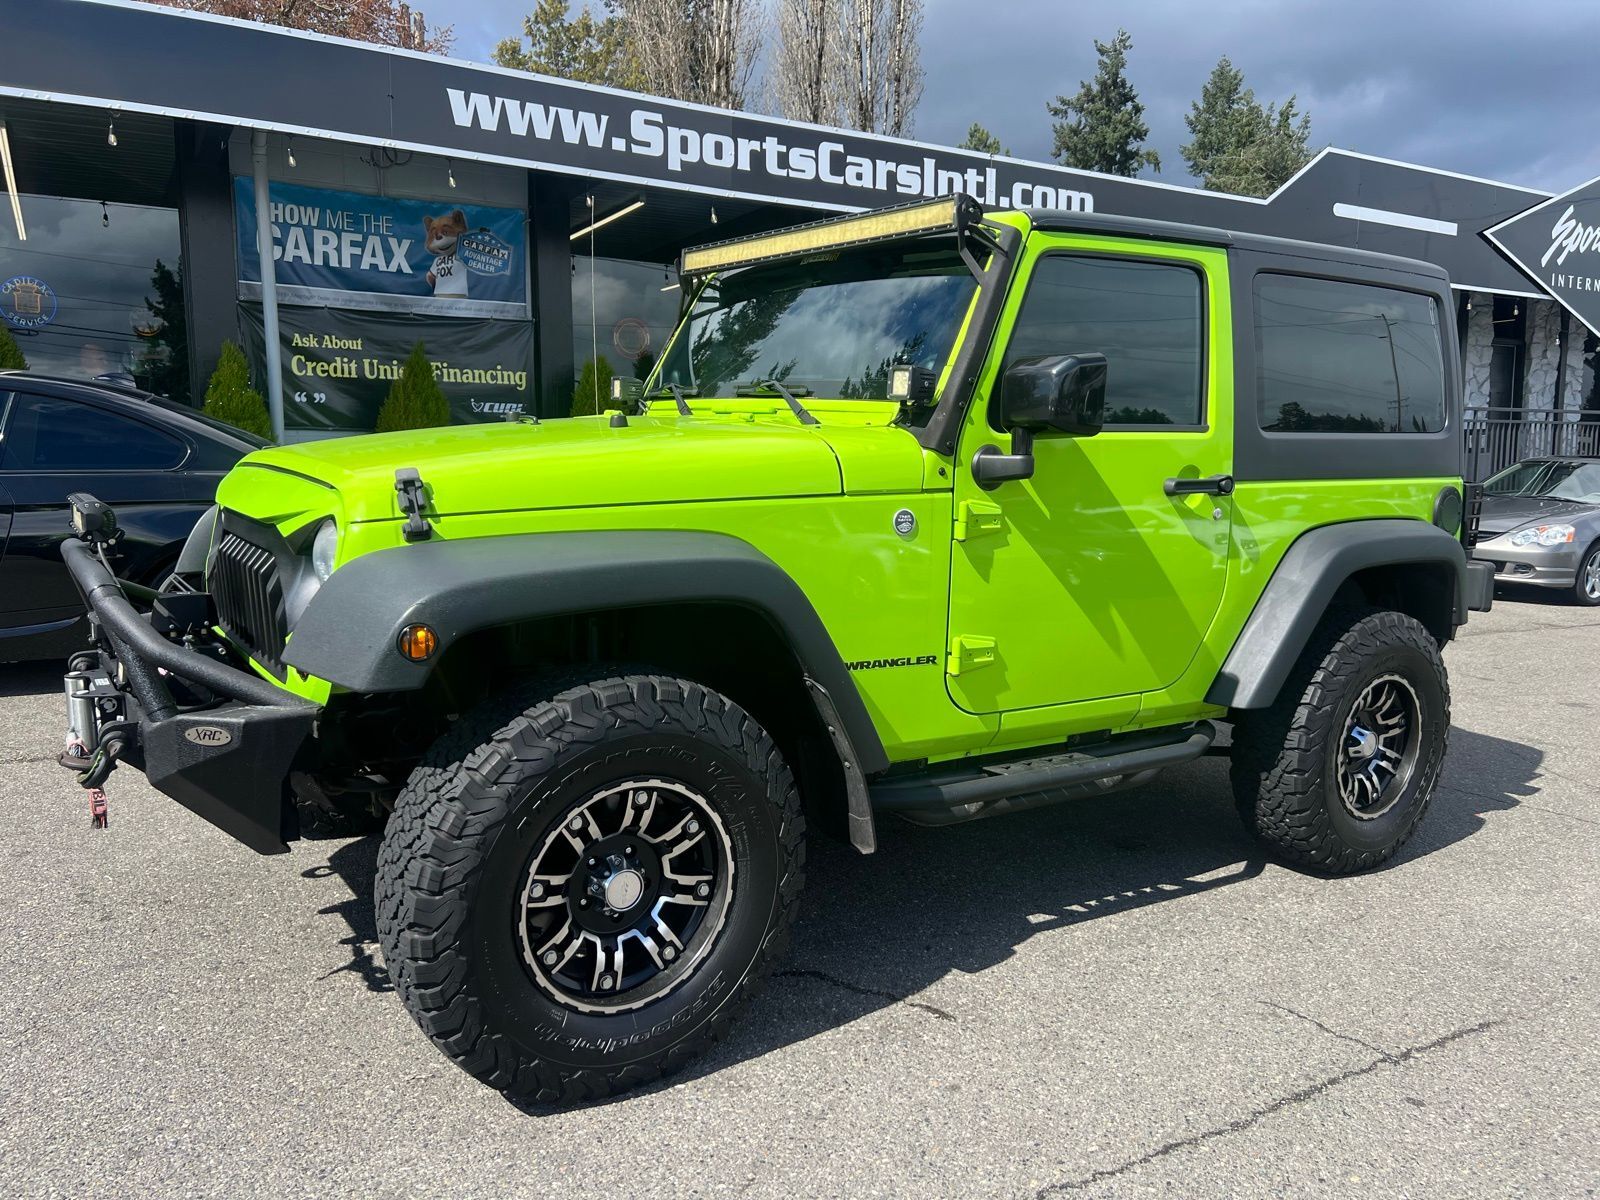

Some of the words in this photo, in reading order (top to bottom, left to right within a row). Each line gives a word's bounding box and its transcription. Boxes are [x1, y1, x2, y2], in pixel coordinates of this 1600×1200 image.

[269, 202, 321, 227] HOW
[326, 209, 354, 231] ME
[358, 213, 393, 235] THE
[1541, 204, 1600, 268] Spor
[463, 240, 508, 260] CARFAX
[435, 254, 454, 267] CAR
[463, 250, 503, 267] ADVANTAGE
[467, 259, 495, 273] DEALER
[436, 265, 454, 278] FOX
[8, 312, 49, 326] SERVICE
[291, 333, 319, 348] Ask
[321, 335, 363, 350] About
[290, 355, 358, 378] Credit
[362, 358, 405, 380] Uni
[430, 361, 527, 391] Financing
[844, 655, 938, 671] WRANGLER
[193, 728, 223, 742] XRC
